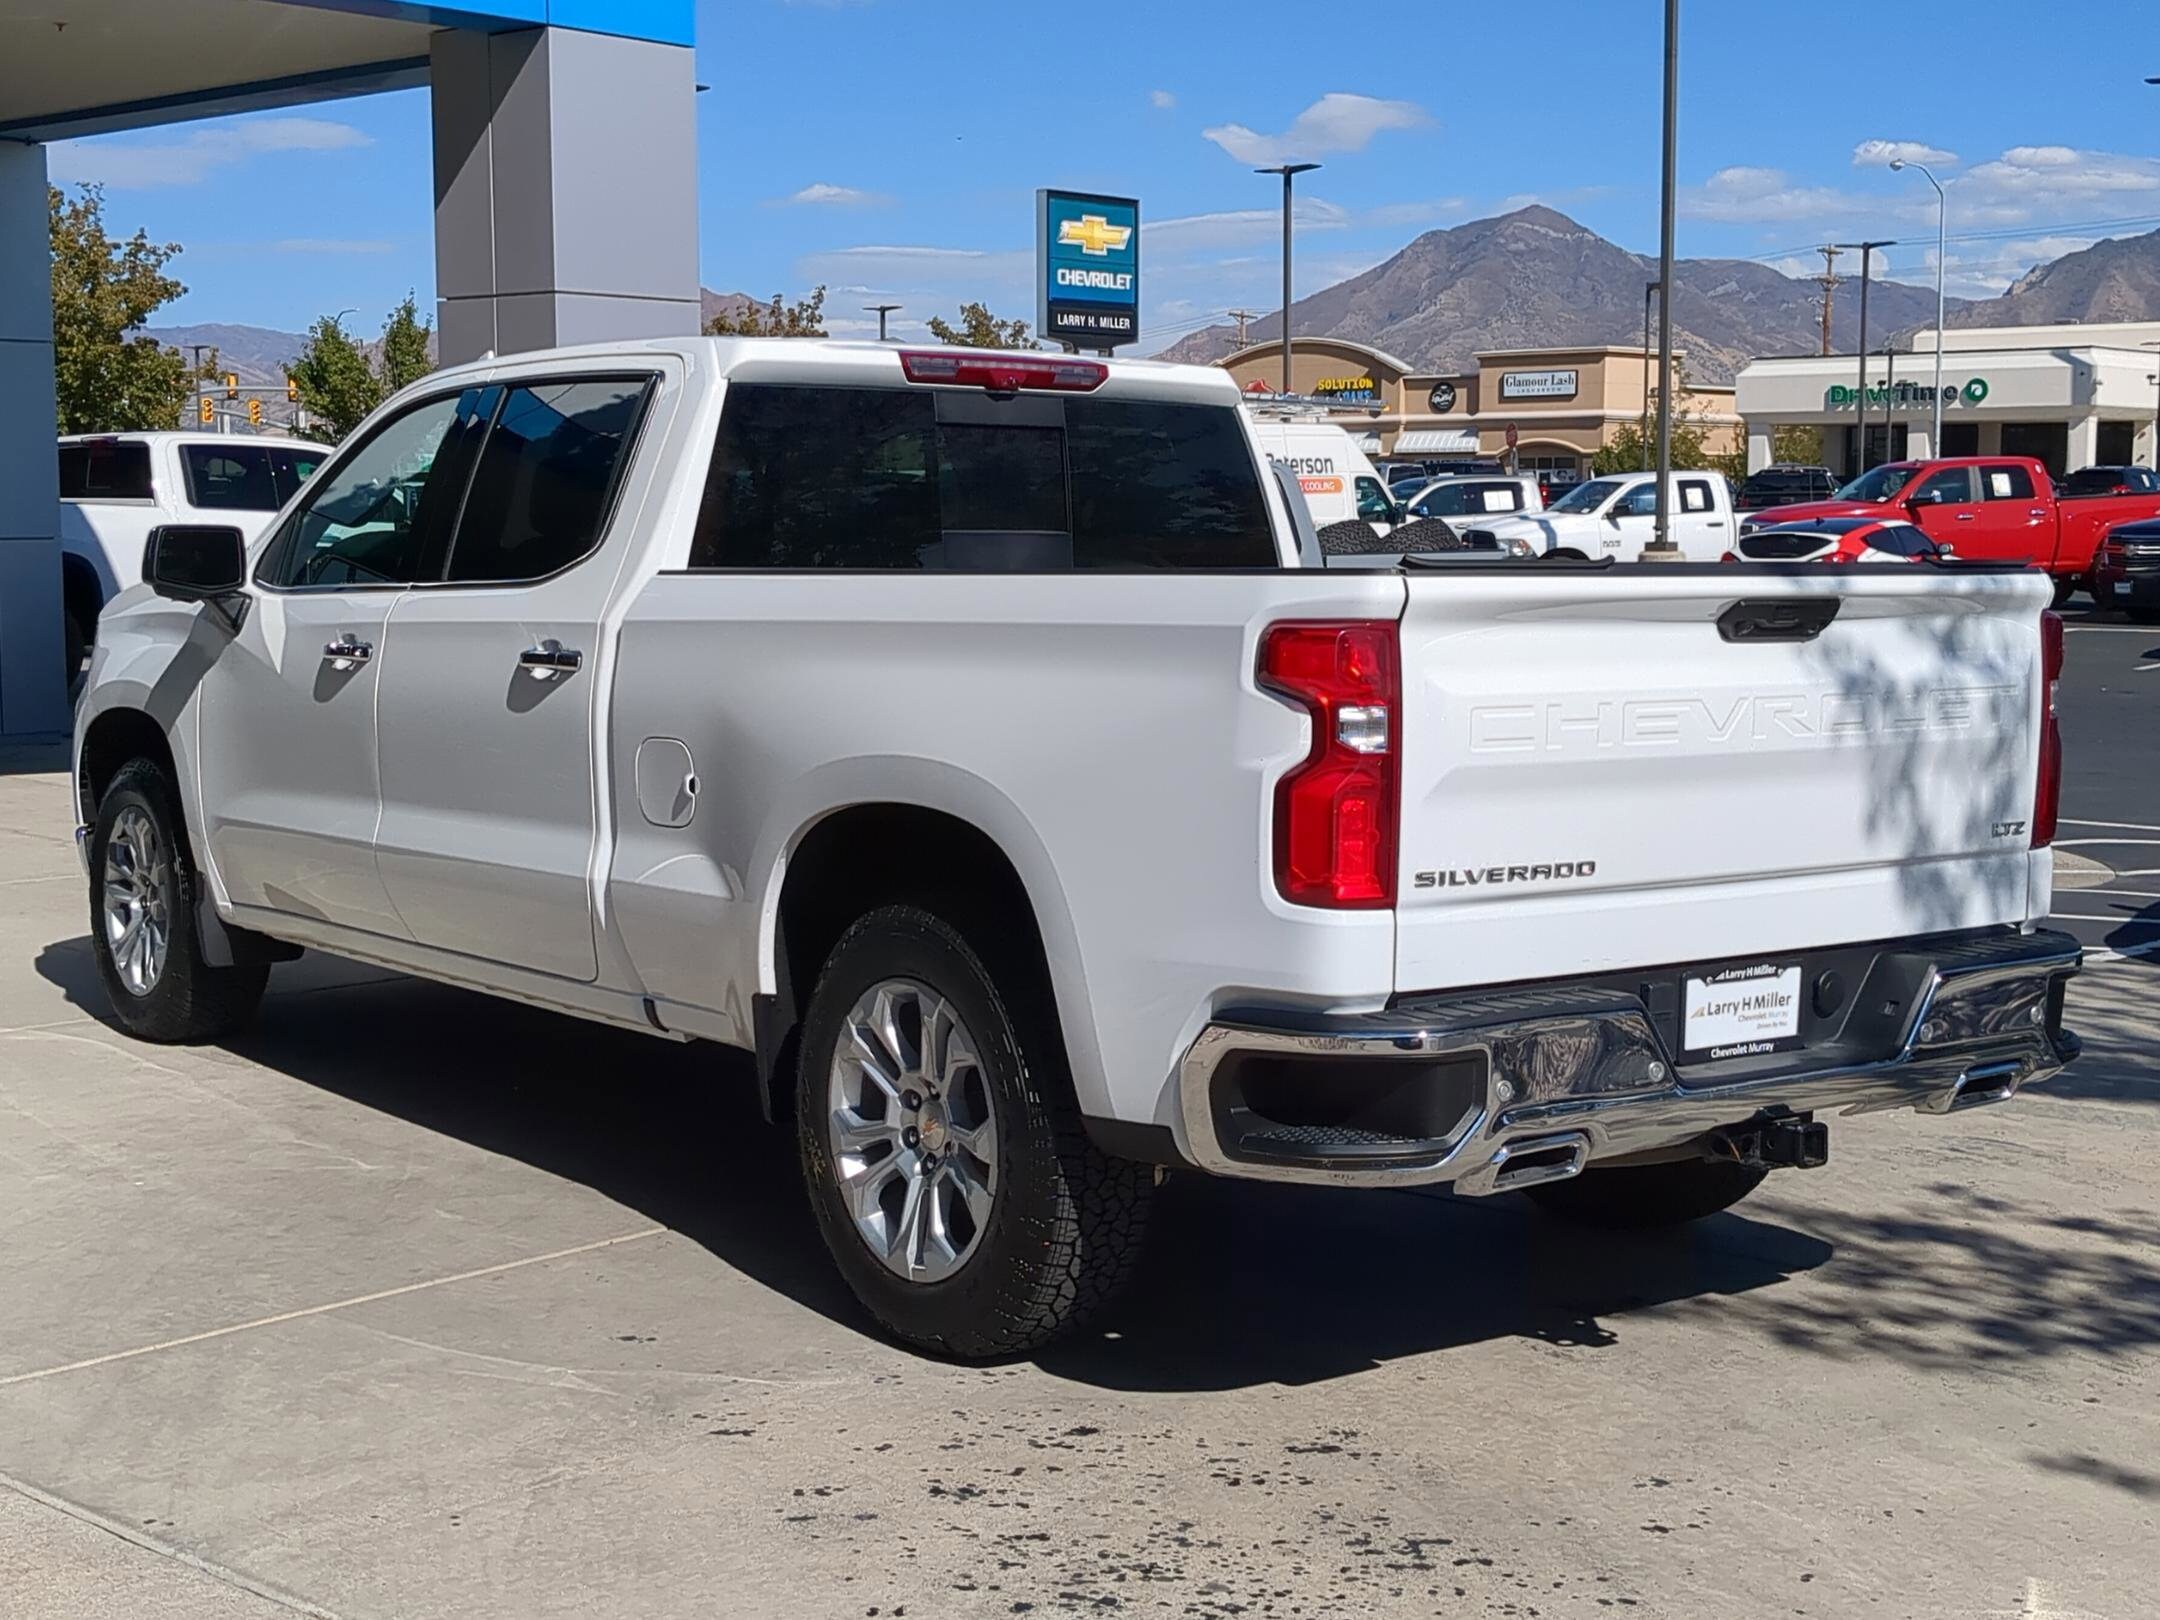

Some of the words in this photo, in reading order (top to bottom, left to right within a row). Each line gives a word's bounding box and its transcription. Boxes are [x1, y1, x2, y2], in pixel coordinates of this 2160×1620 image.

[1057, 268, 1133, 290] CHEVROLET
[1057, 313, 1086, 327] LARRY
[1088, 316, 1098, 327] H.
[1100, 317, 1131, 329] MILLER
[1317, 377, 1374, 391] SOLUTION
[1505, 375, 1549, 387] Glamour
[1551, 373, 1575, 386] Lash
[1829, 383, 1958, 403] DrveTime
[1304, 482, 1336, 492] COOLING
[1991, 821, 2026, 838] LTZ
[1414, 861, 1596, 888] SILVERADO
[1725, 969, 1746, 981] Larry
[1746, 966, 1753, 977] H
[1754, 964, 1777, 976] Miller
[1707, 1001, 1740, 1016] Larry
[1742, 997, 1752, 1011] H
[1754, 992, 1792, 1009] Miller
[1710, 1044, 1748, 1058] Chevrolet
[1748, 1041, 1775, 1054] Murray
